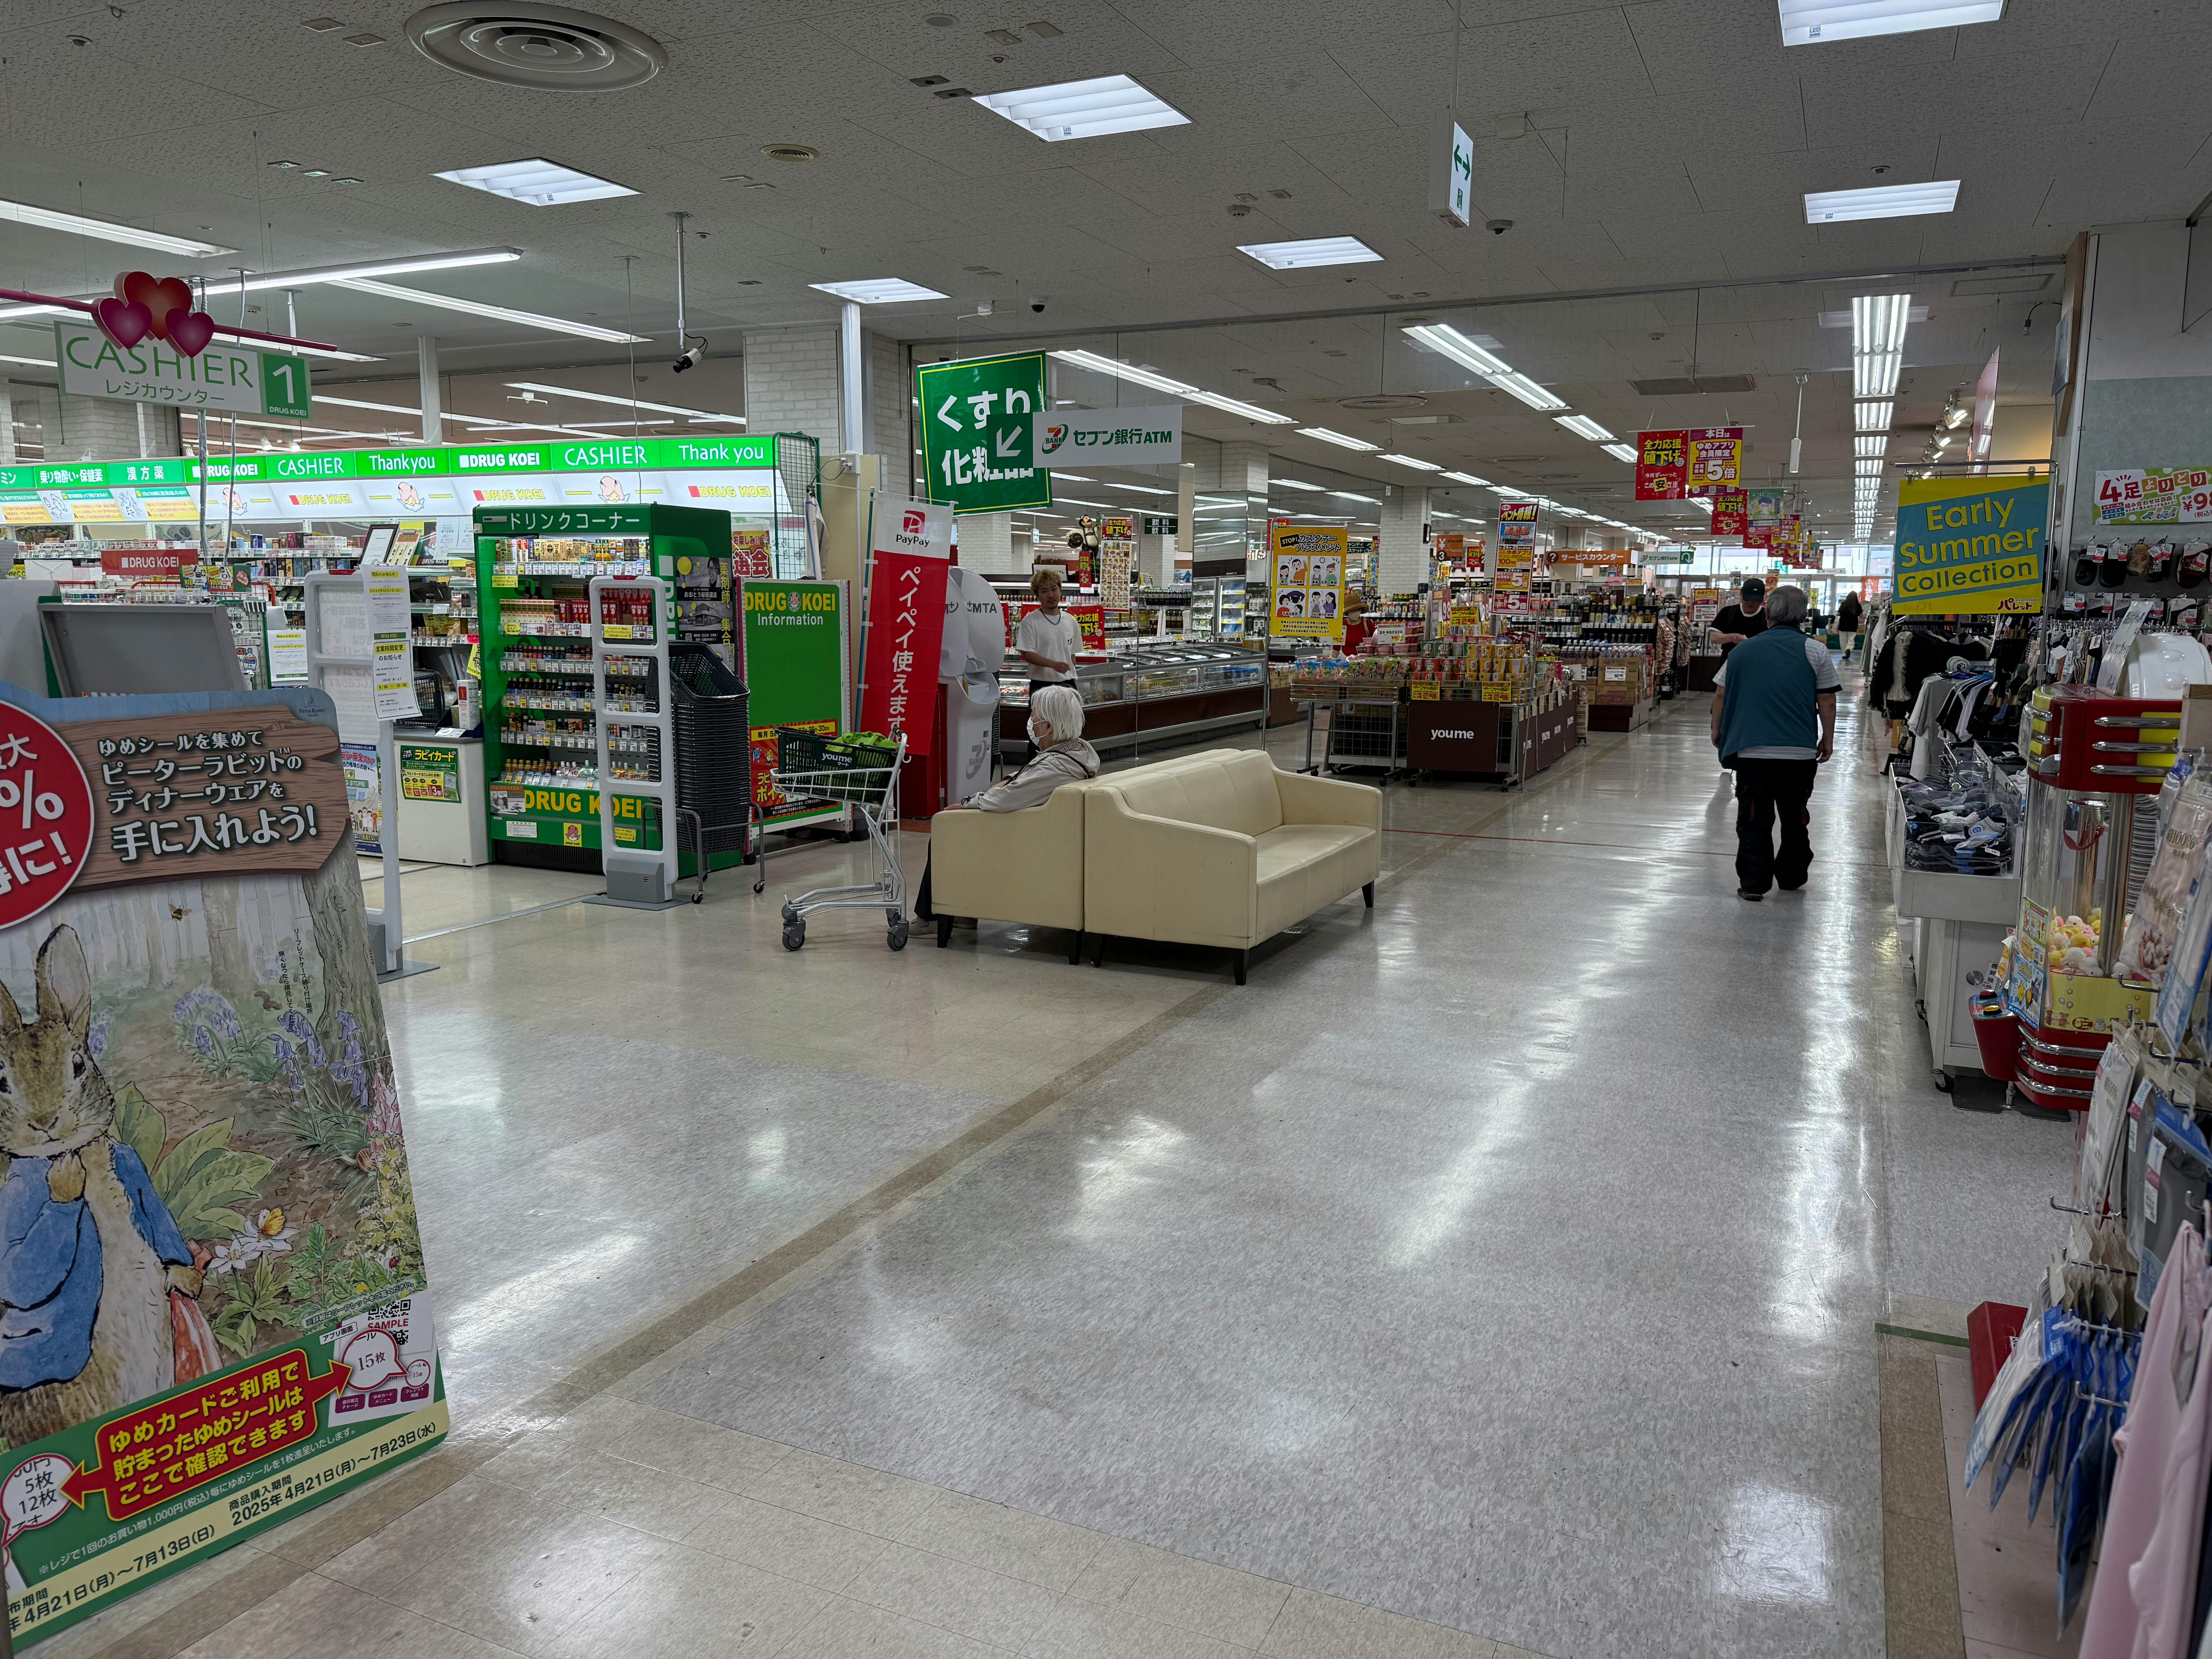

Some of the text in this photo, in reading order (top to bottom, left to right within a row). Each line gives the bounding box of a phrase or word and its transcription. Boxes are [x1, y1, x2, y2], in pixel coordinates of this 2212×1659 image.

[66, 336, 254, 388] CASHIER
[106, 378, 225, 404] レジカウンター
[273, 364, 295, 404] 1
[269, 407, 307, 417] DRUG KOEI
[938, 388, 1030, 432] くすり
[1045, 436, 1064, 445] BANK
[1073, 428, 1172, 447] セブン銀行ATM
[1705, 429, 1730, 438] 本日は
[1644, 438, 1682, 450] 全力応援
[1697, 441, 1735, 450] ゆめアプリ
[469, 452, 540, 467] DRUG KOEI
[565, 447, 647, 465] CASHIER
[678, 444, 764, 464] Thank you
[1644, 450, 1681, 465] 値下げ
[1700, 450, 1730, 458] 会員限定
[127, 465, 164, 481] 漢方薬
[202, 464, 258, 477] RUG KOEI
[278, 457, 344, 476] CASHIER
[40, 468, 104, 484] 乗り物酔い・保健薬
[483, 489, 545, 501] DRUG KOEI
[699, 486, 771, 498] DRUG KOEI
[2100, 472, 2203, 503] 4足 よりどり
[299, 493, 352, 505] DRUG KOEI
[2182, 493, 2212, 512] ¥9
[510, 512, 640, 530] ドリンクコーナー
[1926, 497, 2014, 531] Early
[2194, 510, 2212, 518] (税込
[896, 533, 930, 547] PayPay
[1282, 536, 1297, 544] STOP!
[1298, 534, 1337, 543] カスタマー
[1296, 543, 1341, 552] ハラスメント
[1439, 551, 1445, 560] 3
[1900, 527, 2039, 568] Summer
[129, 556, 179, 569] DRUG KOEI
[1903, 560, 2032, 592] Collection
[745, 592, 836, 611] DRUG KOEI
[1997, 598, 2032, 611] パレット
[757, 613, 823, 626] Information
[376, 644, 404, 653] 営業時間変更
[1431, 728, 1474, 740] youme
[0, 733, 37, 769] 大
[99, 730, 263, 757] ゆめシールを集めて
[822, 752, 852, 763] youme
[1894, 758, 1911, 768] PLEA
[107, 780, 285, 815] ディナーウェアを
[524, 790, 581, 813] DRUG
[111, 805, 318, 862] 手に入れよう!
[294, 928, 313, 1015] リーフレットケース貼り付け場所
[368, 1318, 409, 1329] SAMPLE
[323, 1326, 354, 1342] アプリ画面
[357, 1352, 386, 1371] 15枚
[110, 1361, 300, 1453] ゆめカードご利用で
[113, 1385, 304, 1482] 貯まったゆめシールは
[119, 1409, 308, 1505] ここで確認できます
[25, 1470, 54, 1494] 5枚
[19, 1487, 58, 1515] 12枚
[228, 1474, 292, 1512] 商品購入期間
[231, 1493, 283, 1526] 2025年
